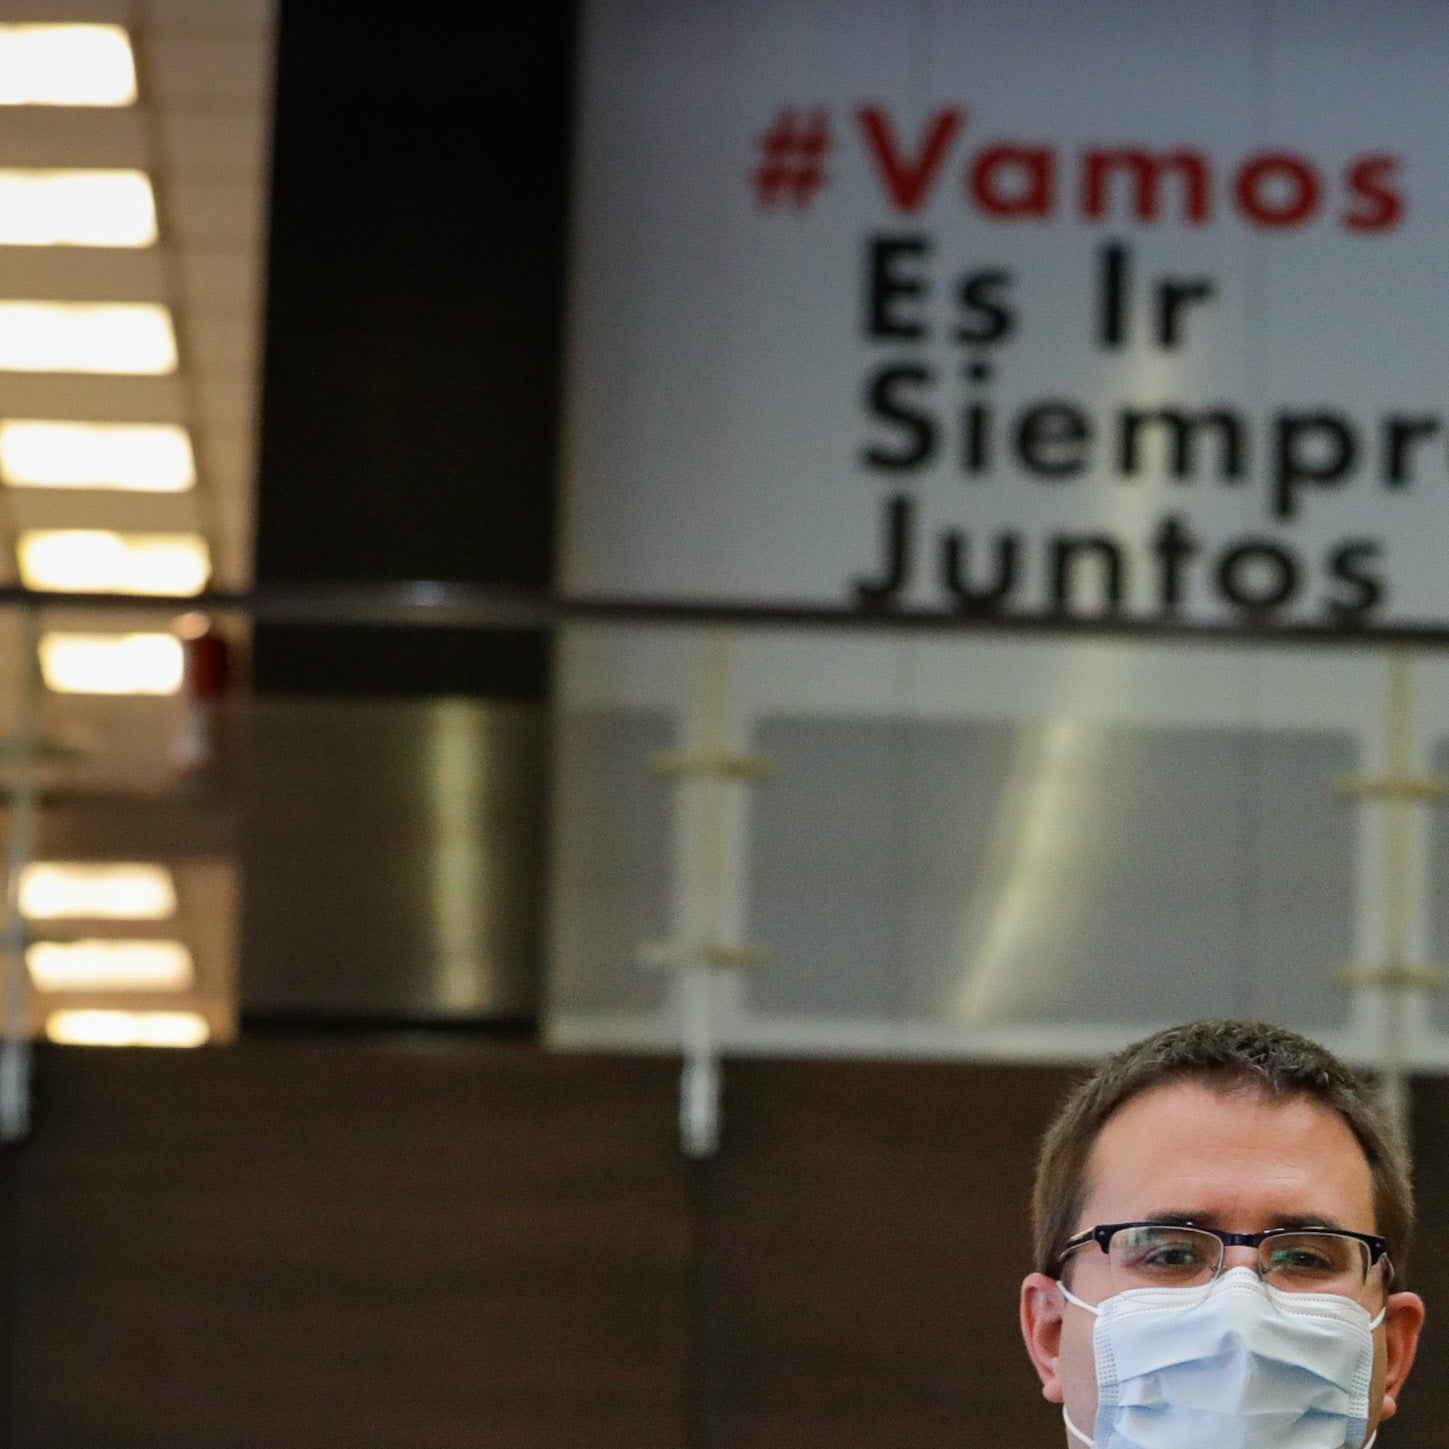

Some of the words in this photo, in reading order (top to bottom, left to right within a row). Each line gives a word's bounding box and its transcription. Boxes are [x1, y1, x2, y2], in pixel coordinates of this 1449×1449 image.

[752, 100, 1406, 233] #Vamos
[863, 232, 1014, 346] Es
[1101, 240, 1213, 349] Ir
[855, 492, 1385, 622] Juntos
